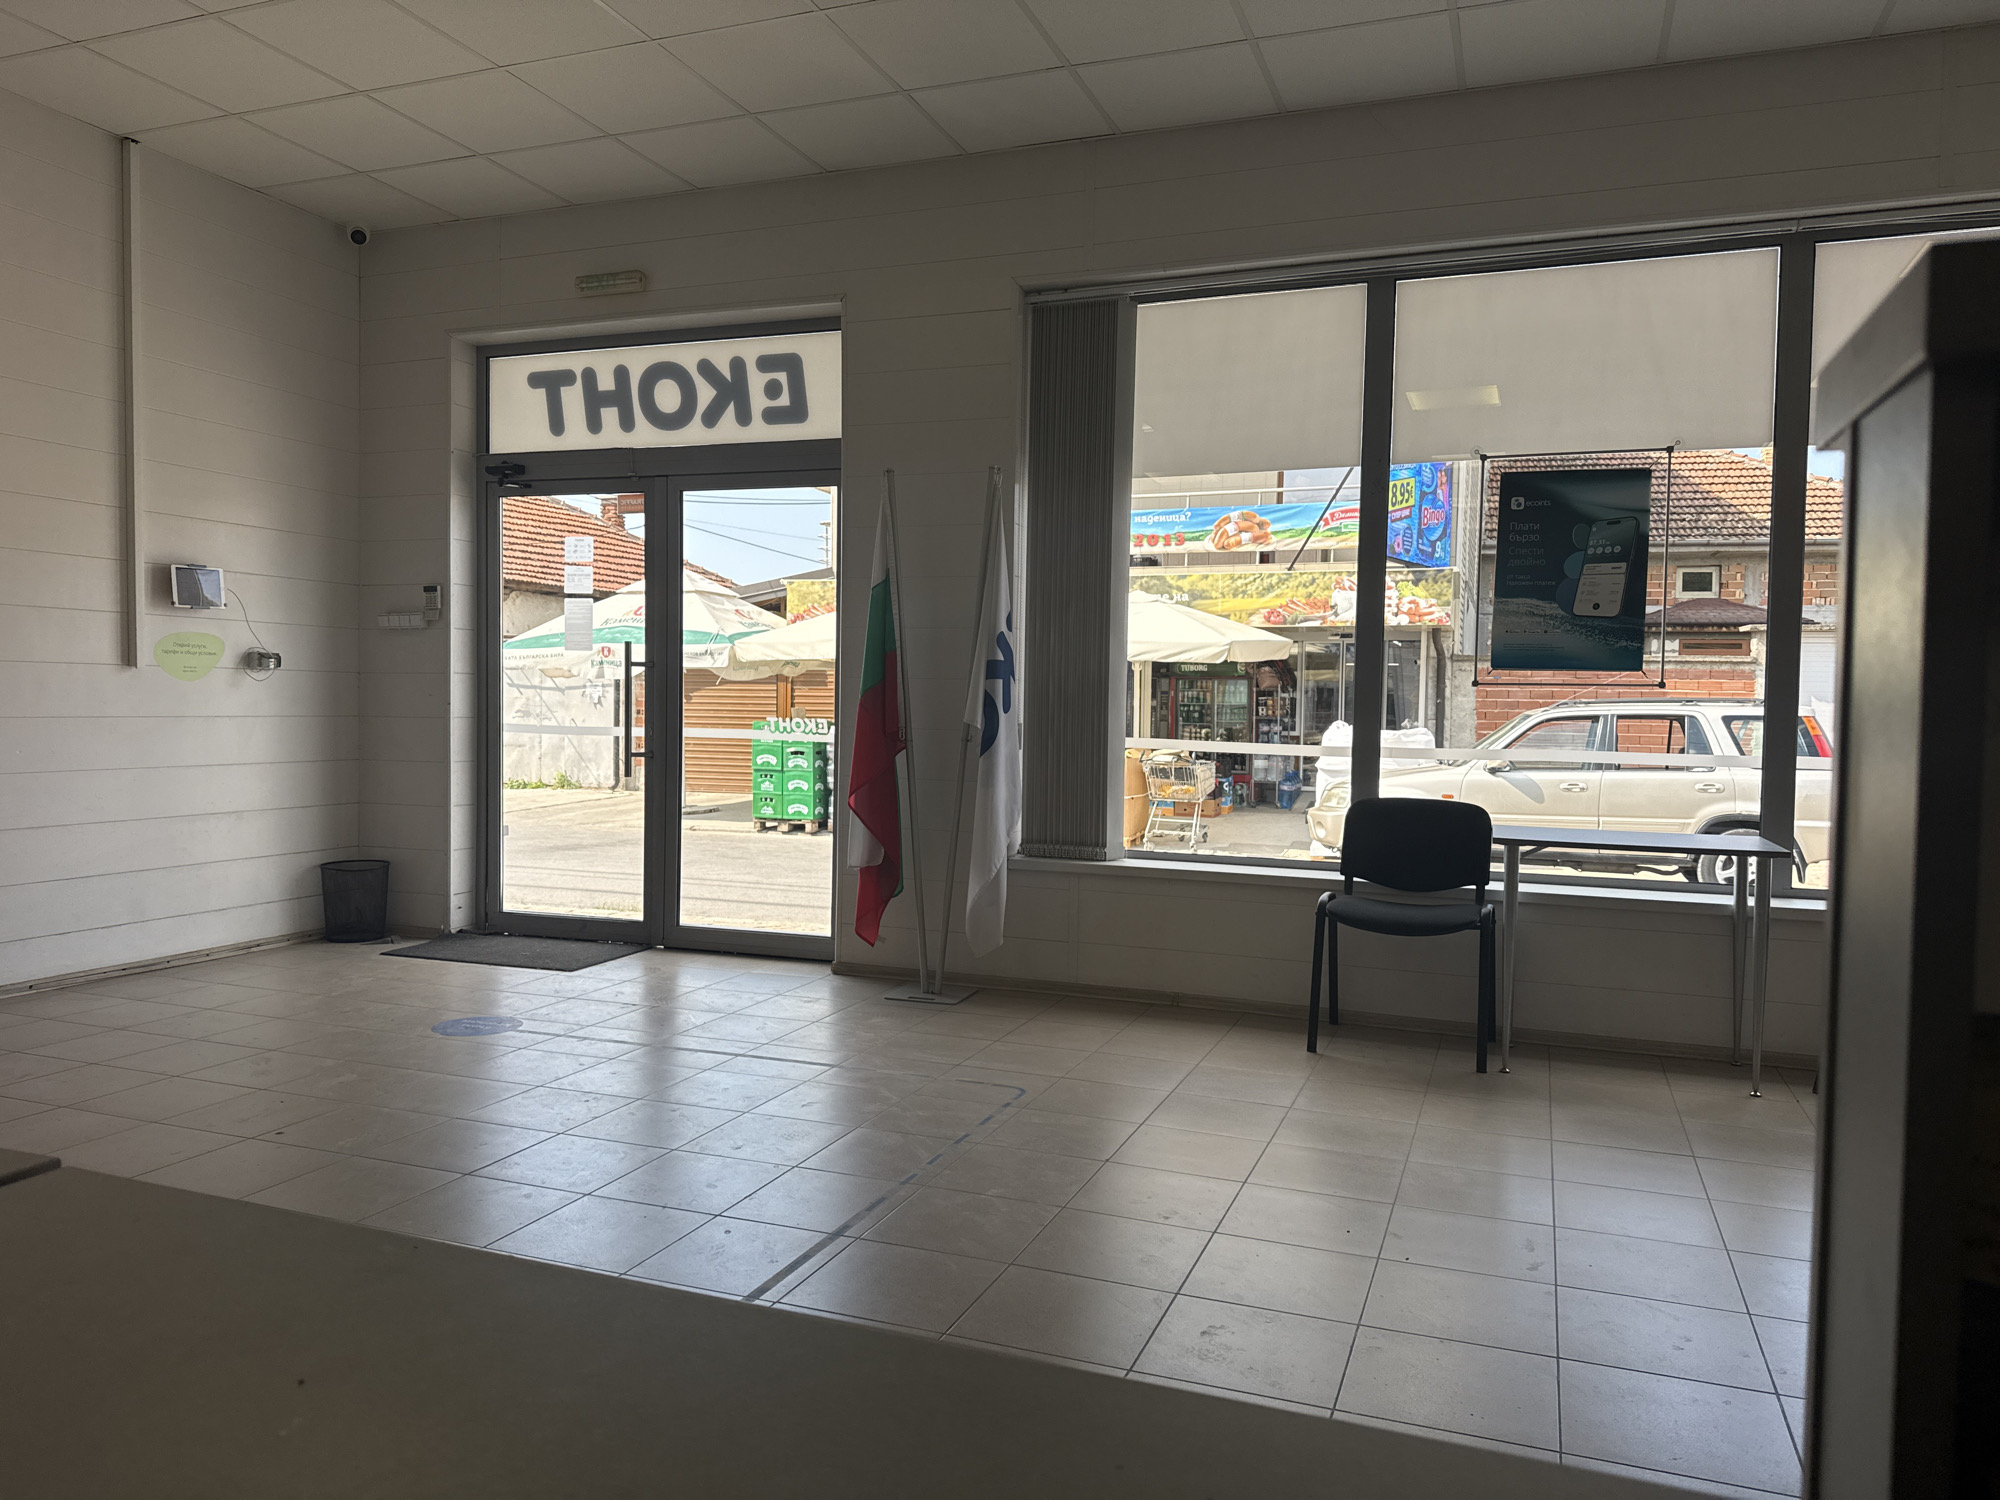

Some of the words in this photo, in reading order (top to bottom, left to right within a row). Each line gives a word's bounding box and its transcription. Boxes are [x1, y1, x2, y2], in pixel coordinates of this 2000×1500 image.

[1134, 511, 1192, 525] наденица?
[1421, 506, 1446, 529] Bingo
[1509, 521, 1541, 531] Плати
[1133, 532, 1186, 547] 2013
[1508, 546, 1545, 556] Спести
[1507, 557, 1546, 568] двойно
[1180, 664, 1208, 672] TUBORG
